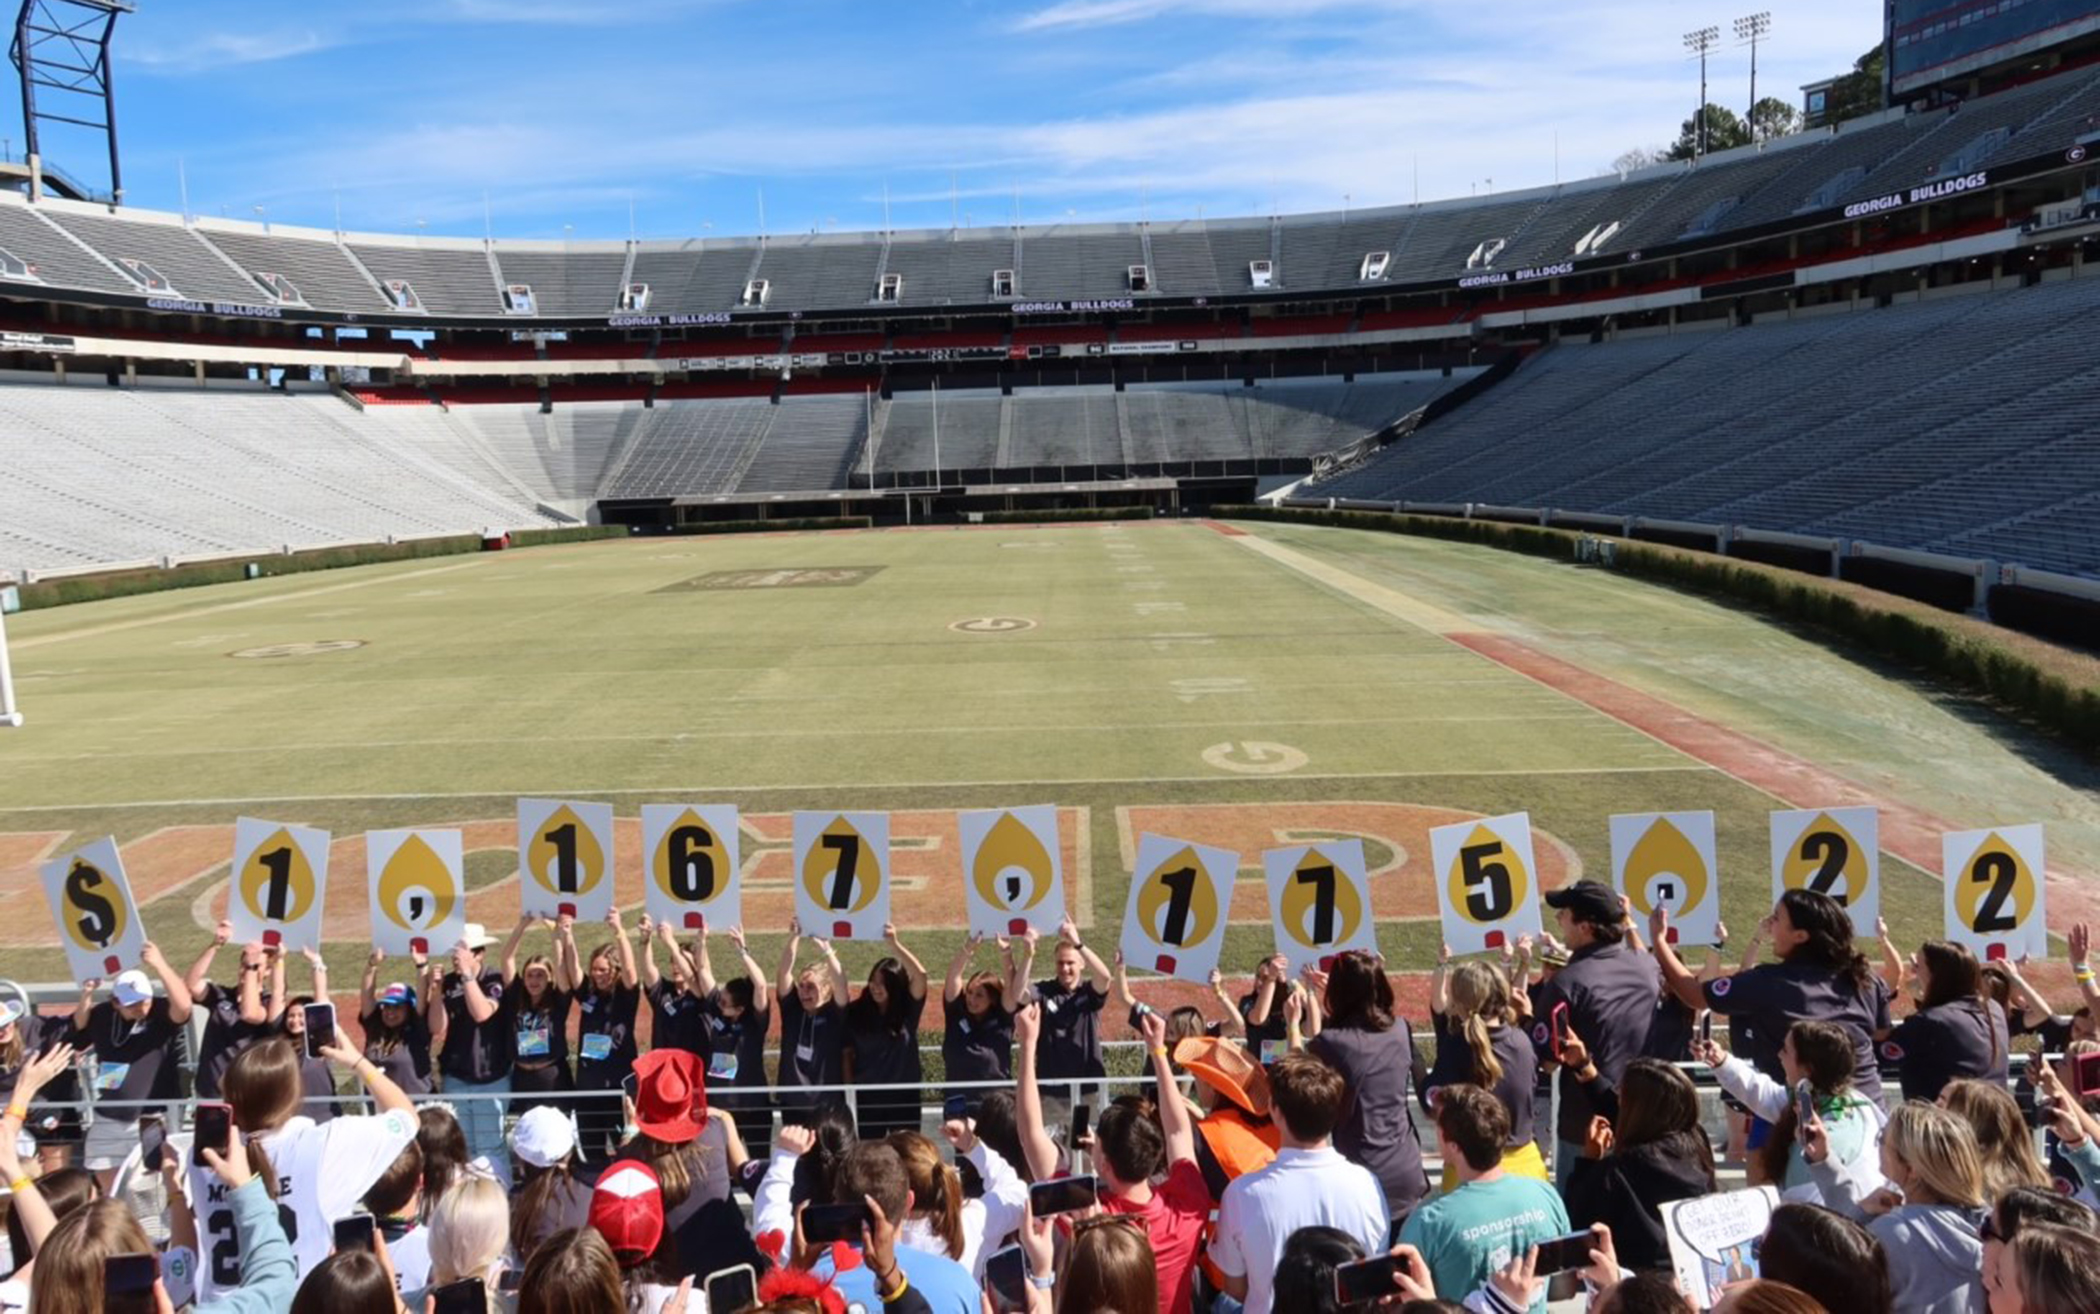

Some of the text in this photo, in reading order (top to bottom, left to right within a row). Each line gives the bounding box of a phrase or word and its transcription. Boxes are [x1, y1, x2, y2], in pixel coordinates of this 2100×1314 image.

[1844, 171, 1986, 217] GEORGIA BULLDOGS
[147, 299, 282, 318] GEORGIA BULLDOGS
[1011, 298, 1134, 312] GEORGIA BULLDOGS
[1459, 262, 1574, 287] GEORGIA BULLDOGS
[608, 313, 731, 326] GEORGIA BULLDOGS
[260, 846, 291, 920] 1
[545, 824, 577, 893] 1
[668, 825, 714, 902] 6
[822, 834, 859, 910] 7
[1006, 877, 1021, 902] ,
[1460, 841, 1512, 922] 5
[1802, 831, 1848, 908] 2
[1972, 851, 2017, 933] 2
[66, 861, 116, 948] $
[410, 897, 423, 920] ,
[1160, 867, 1197, 946] 1
[1296, 865, 1336, 945] 7
[1462, 1208, 1546, 1241] sponsorship
